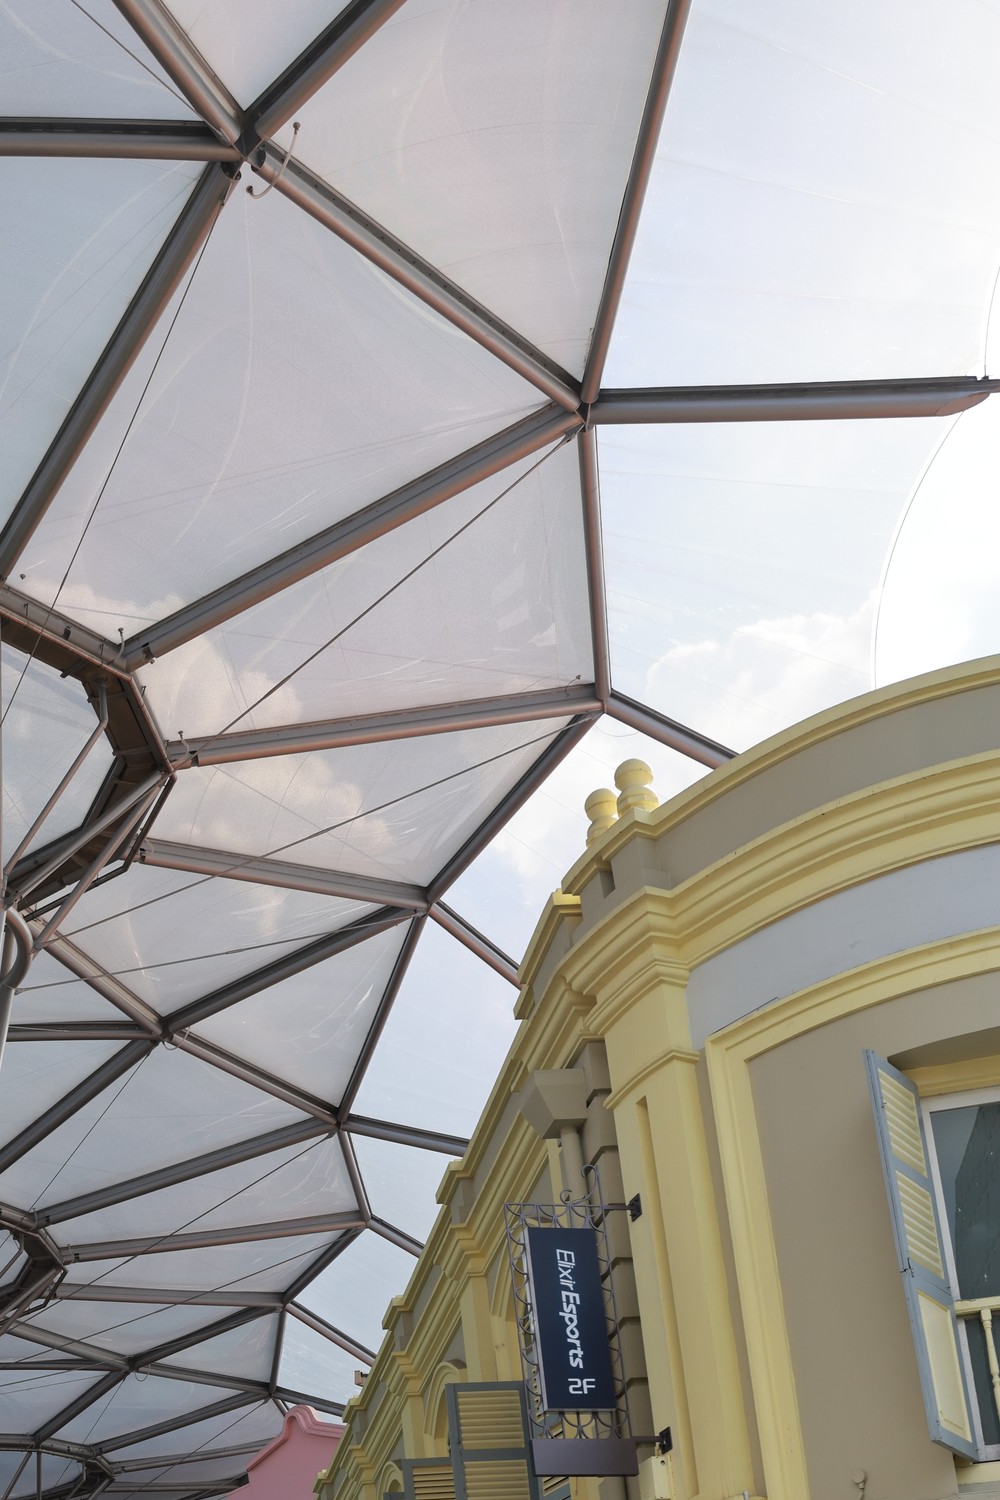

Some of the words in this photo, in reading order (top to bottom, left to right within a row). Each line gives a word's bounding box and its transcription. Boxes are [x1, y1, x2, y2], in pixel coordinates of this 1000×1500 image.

[556, 1248, 576, 1291] Elixir
[559, 1290, 585, 1369] Esports
[567, 1377, 596, 1394] 2F
